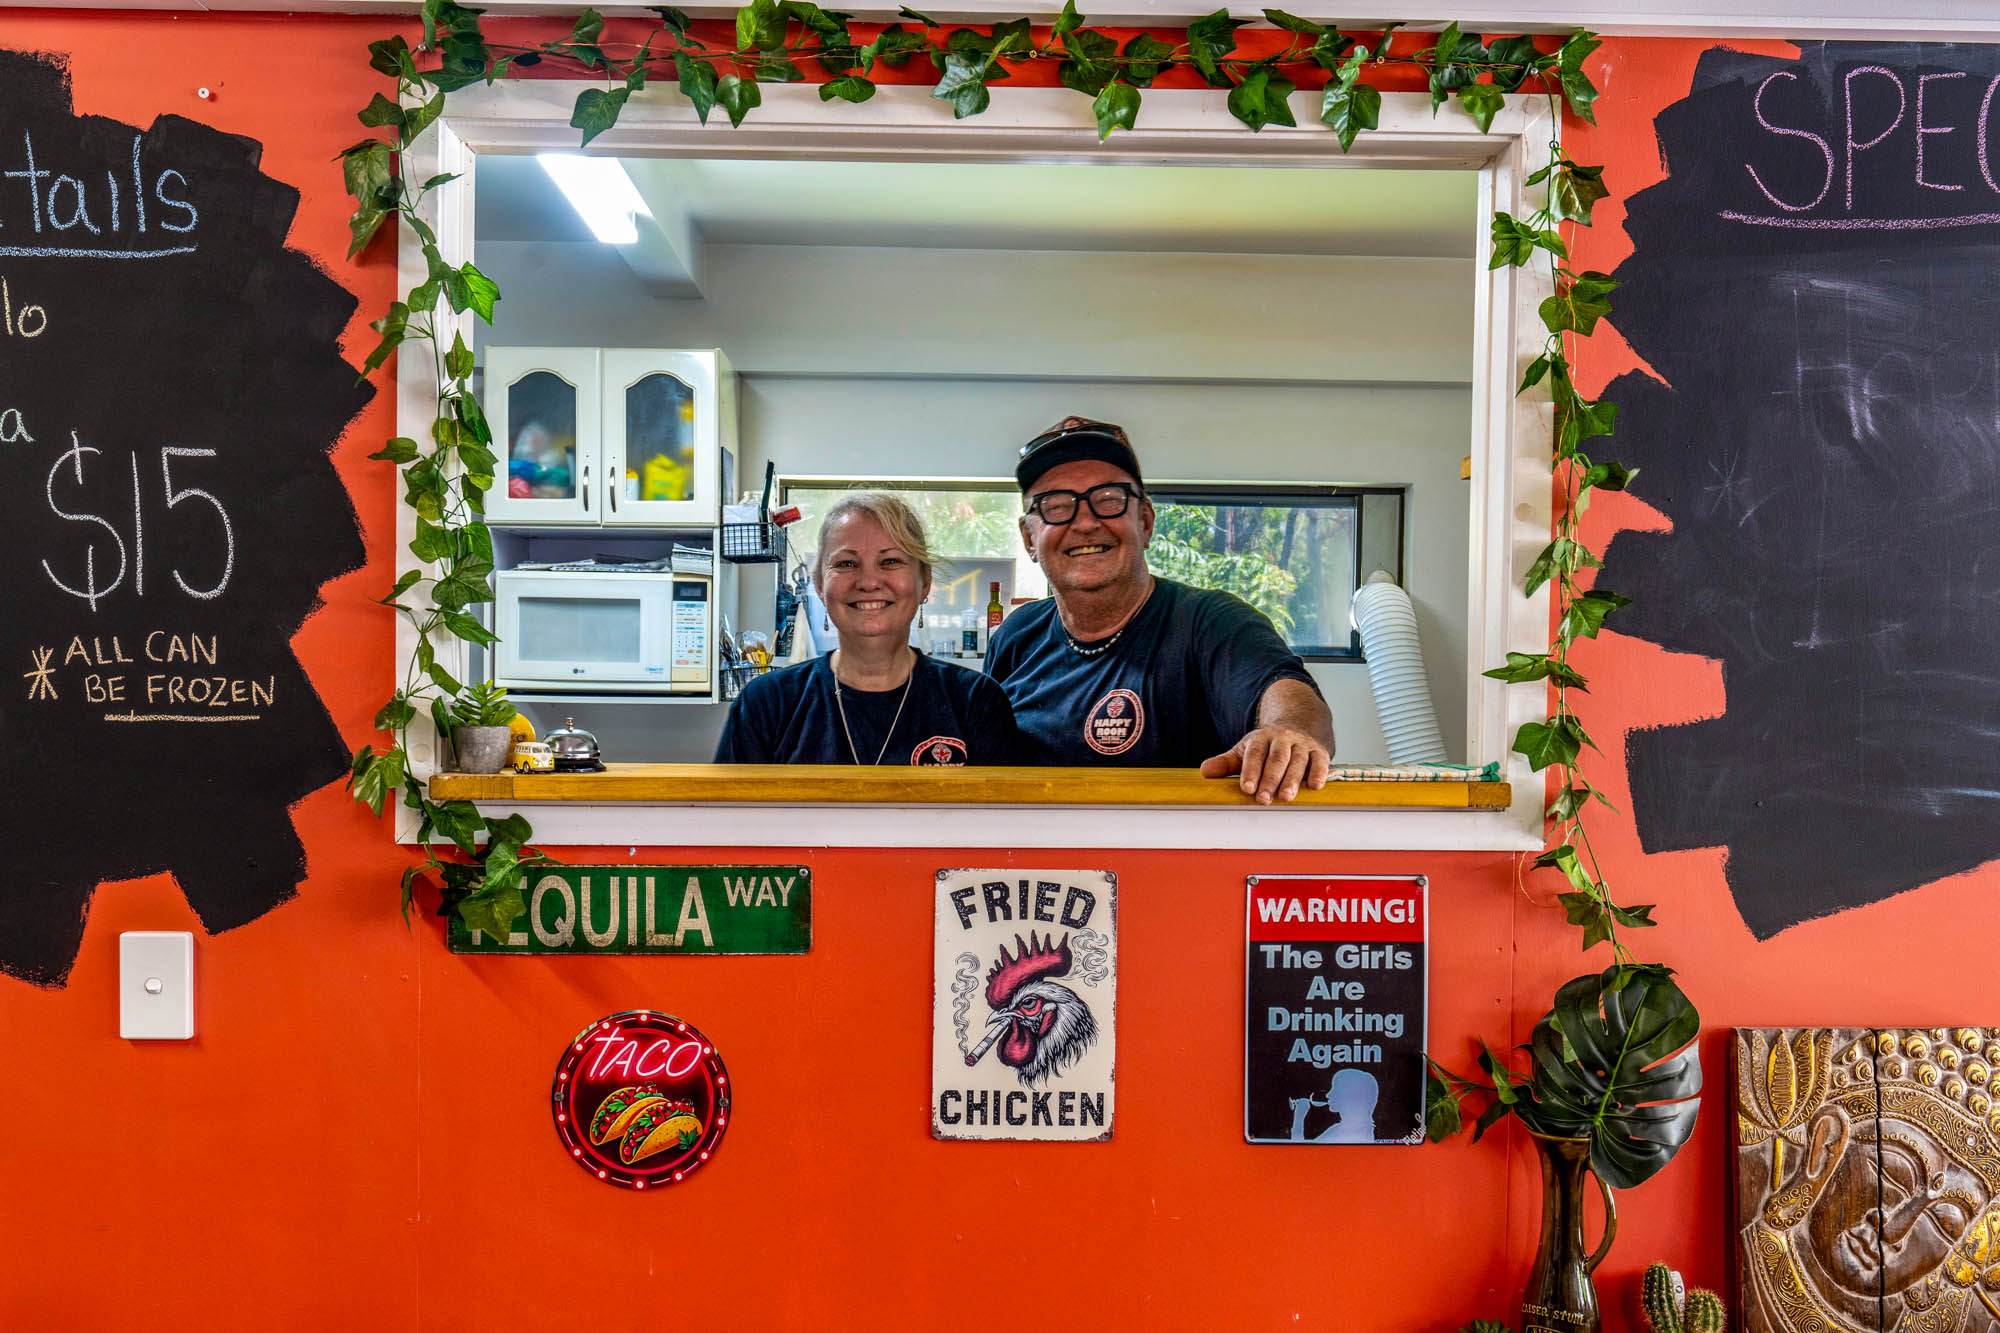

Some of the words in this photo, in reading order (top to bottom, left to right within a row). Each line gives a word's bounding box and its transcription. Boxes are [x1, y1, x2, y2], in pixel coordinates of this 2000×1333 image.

[0, 128, 199, 235] tails
[42, 428, 235, 612] $15
[65, 635, 134, 667] ALL
[146, 630, 217, 665] CAN
[85, 674, 126, 703] BE
[147, 675, 275, 707] FROZEN
[1094, 718, 1133, 728] HAPPY
[1096, 728, 1127, 736] ROOM
[723, 876, 796, 907] WAY
[950, 879, 1096, 930] FRIED
[1257, 898, 1416, 924] WARNING!
[1259, 944, 1324, 969] The
[1335, 944, 1413, 969] Girls
[1305, 975, 1366, 1001] Are
[1267, 1006, 1405, 1038] Drinking
[587, 1026, 703, 1078] TACO
[1287, 1038, 1382, 1069] Again
[939, 1089, 1105, 1127] CHICKEN
